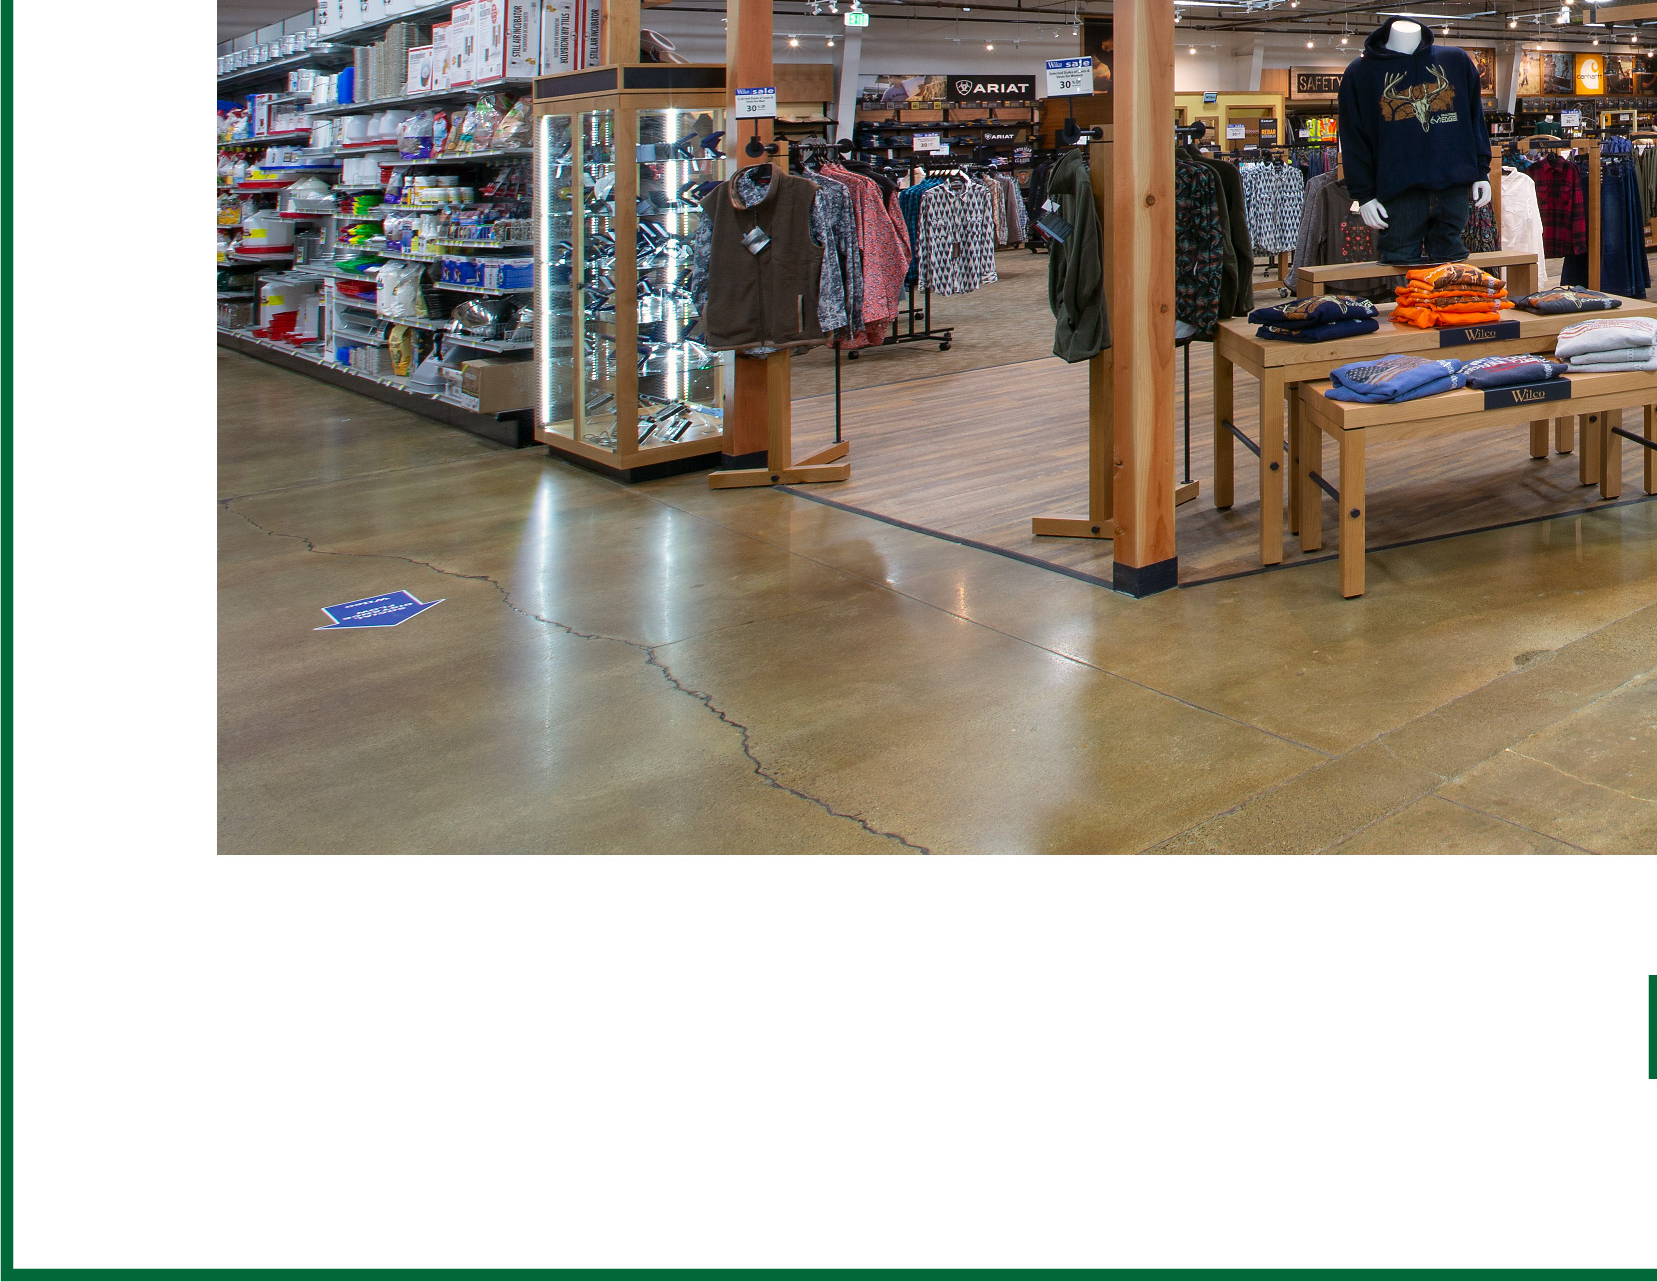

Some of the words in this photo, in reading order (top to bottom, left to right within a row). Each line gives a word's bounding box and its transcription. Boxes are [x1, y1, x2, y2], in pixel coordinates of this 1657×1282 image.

[513, 5, 522, 35] INCUBATOR
[560, 13, 570, 27] STILL
[591, 8, 600, 37] INCUBATOR
[560, 27, 570, 35] AIR
[513, 35, 521, 44] AIR
[590, 37, 599, 46] AIR
[512, 44, 521, 58] STILL
[559, 35, 569, 64] INCUBATOR
[589, 46, 598, 60] STILL
[1065, 59, 1090, 68] sale
[973, 83, 1030, 94] ARIAT
[1060, 80, 1071, 89] 30
[1299, 76, 1343, 91] SAFETY
[752, 87, 774, 95] sale
[1464, 329, 1497, 341] Wilco
[1511, 388, 1546, 403] Wilco
